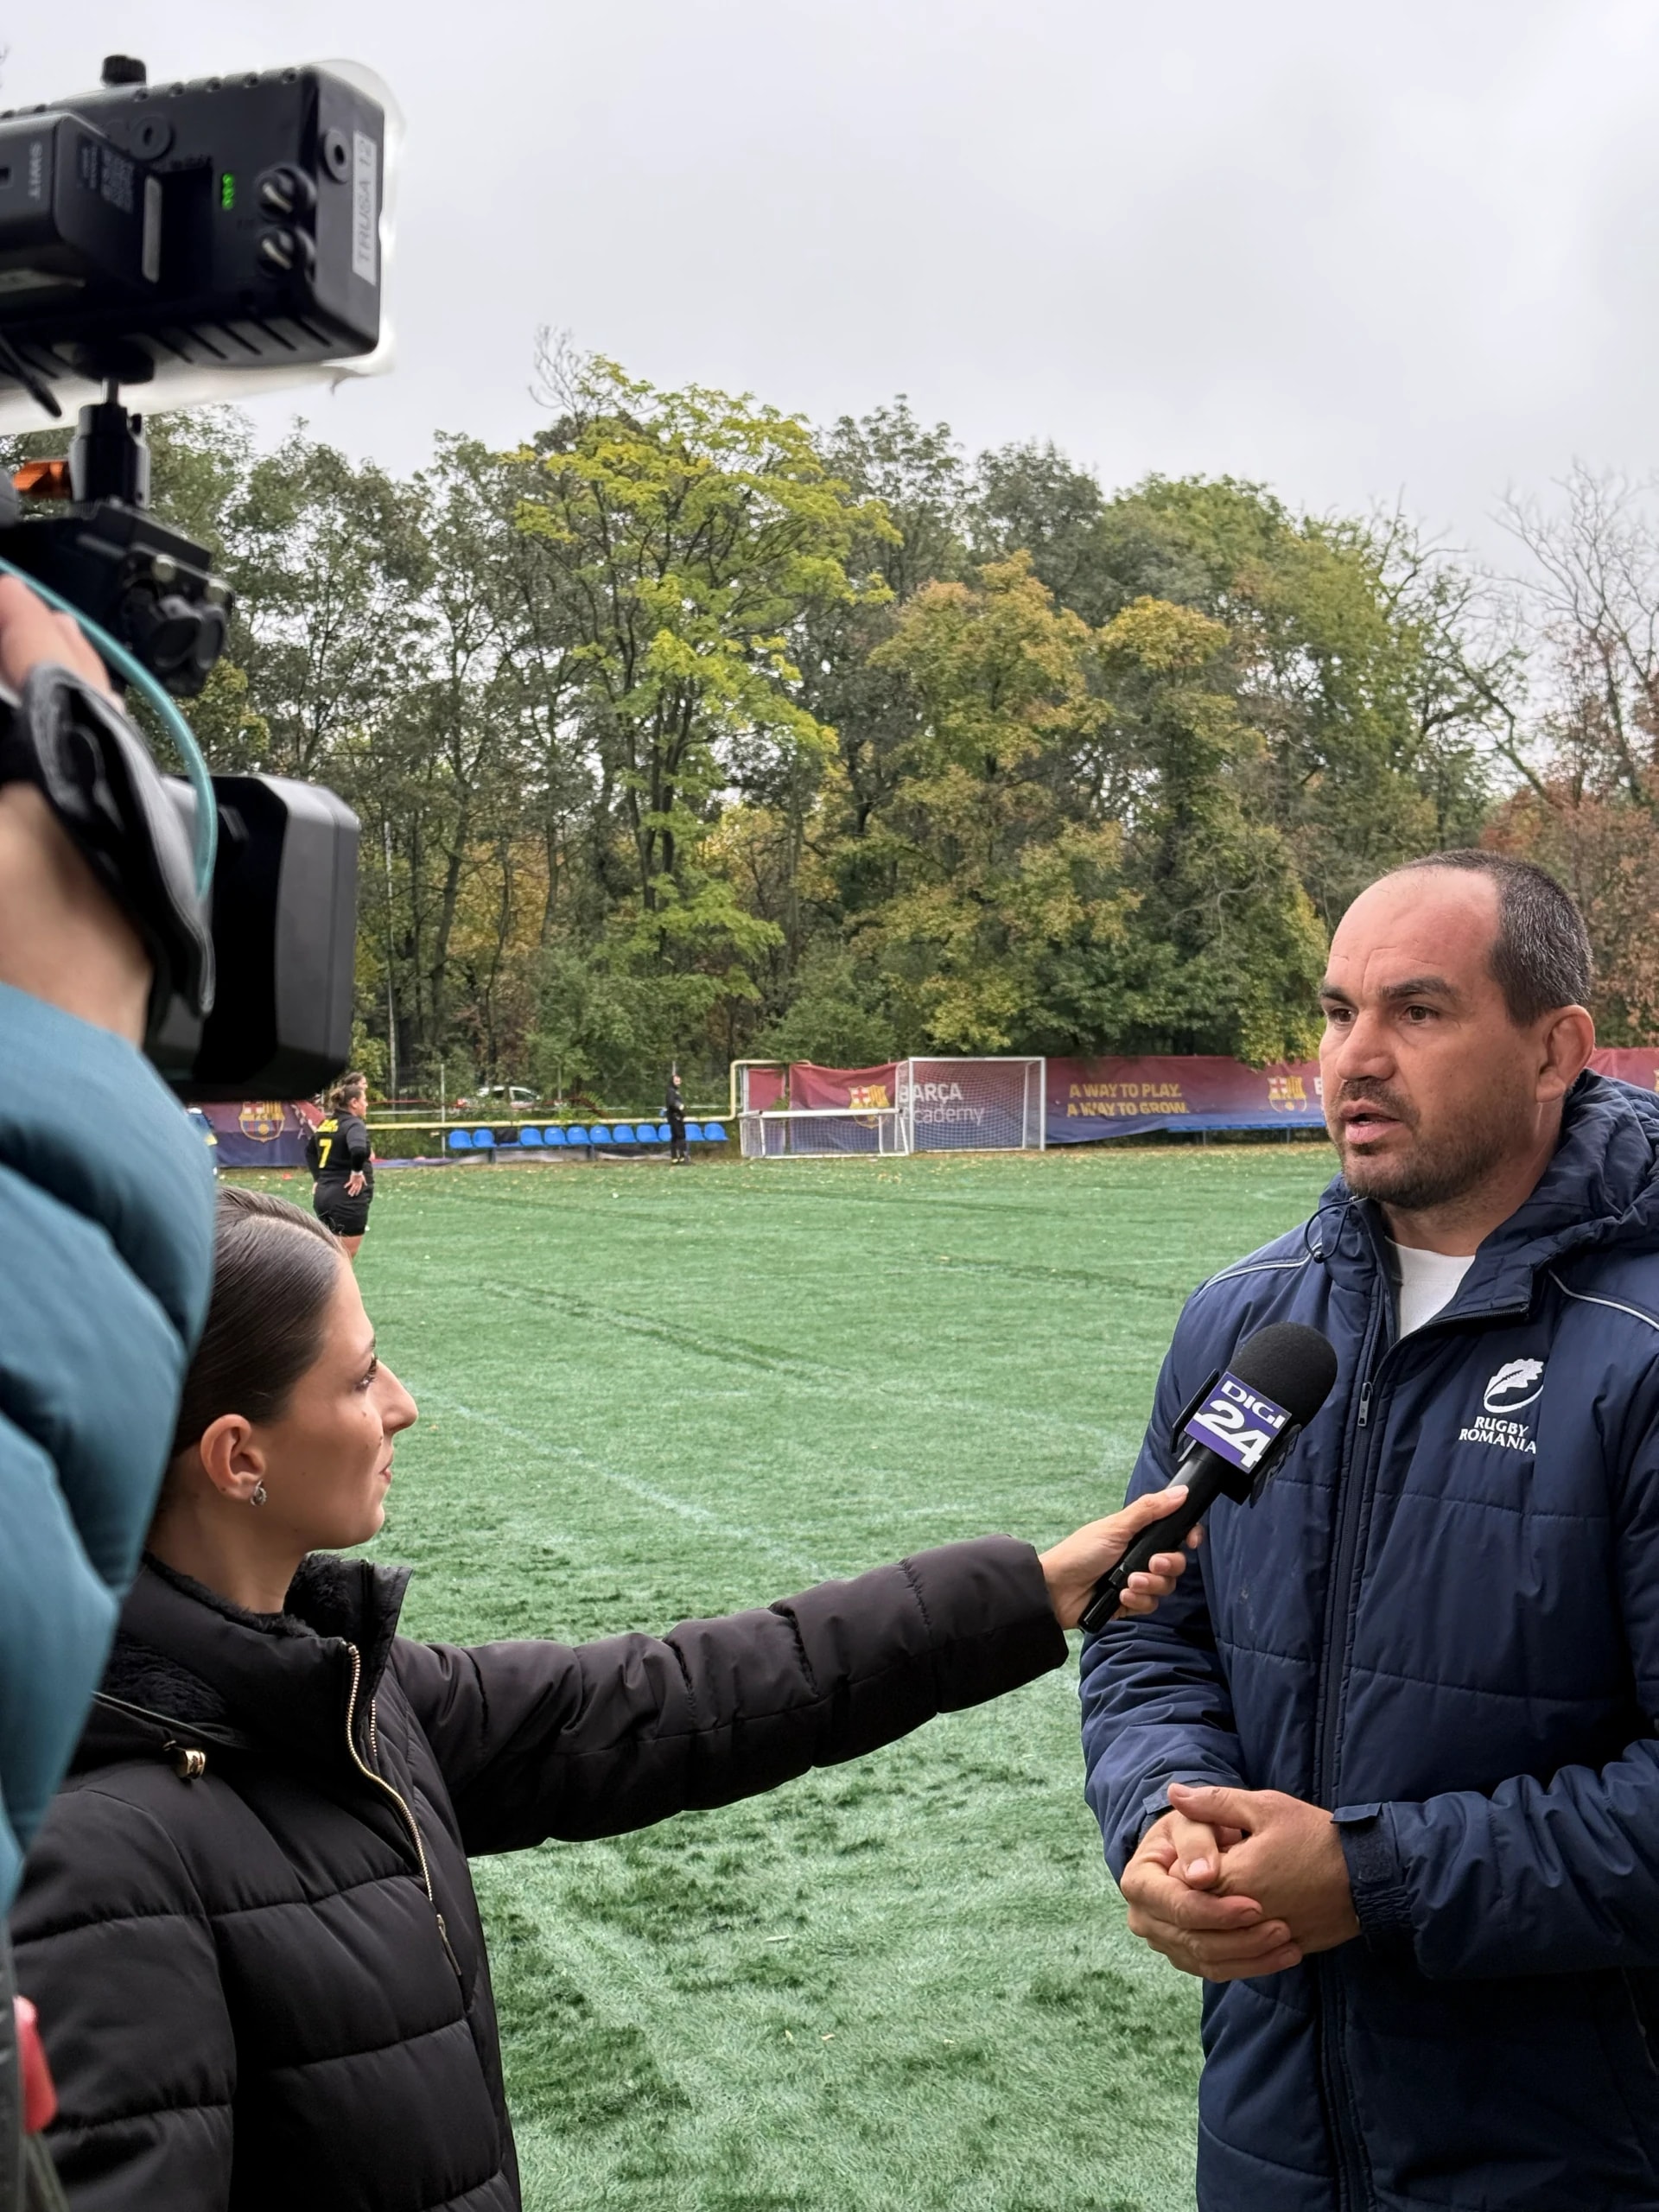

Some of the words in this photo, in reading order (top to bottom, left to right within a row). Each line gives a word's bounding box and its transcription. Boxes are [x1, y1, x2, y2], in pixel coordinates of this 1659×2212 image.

[29, 141, 42, 200] SWIT
[899, 1083, 963, 1103] BARÇA
[1069, 1084, 1080, 1098] A
[1083, 1084, 1117, 1097] WAY
[1120, 1084, 1138, 1097] TO
[1141, 1083, 1182, 1097] PLAY.
[1067, 1103, 1077, 1117] A
[1080, 1103, 1116, 1116] WAY
[1117, 1102, 1137, 1116] TO
[1140, 1101, 1190, 1114] GROW.
[318, 1139, 332, 1168] 7
[1221, 1380, 1286, 1428] DIGI
[1192, 1400, 1270, 1468] 24
[1474, 1416, 1529, 1437] RUGBY
[1459, 1428, 1536, 1454] ROMANIA
